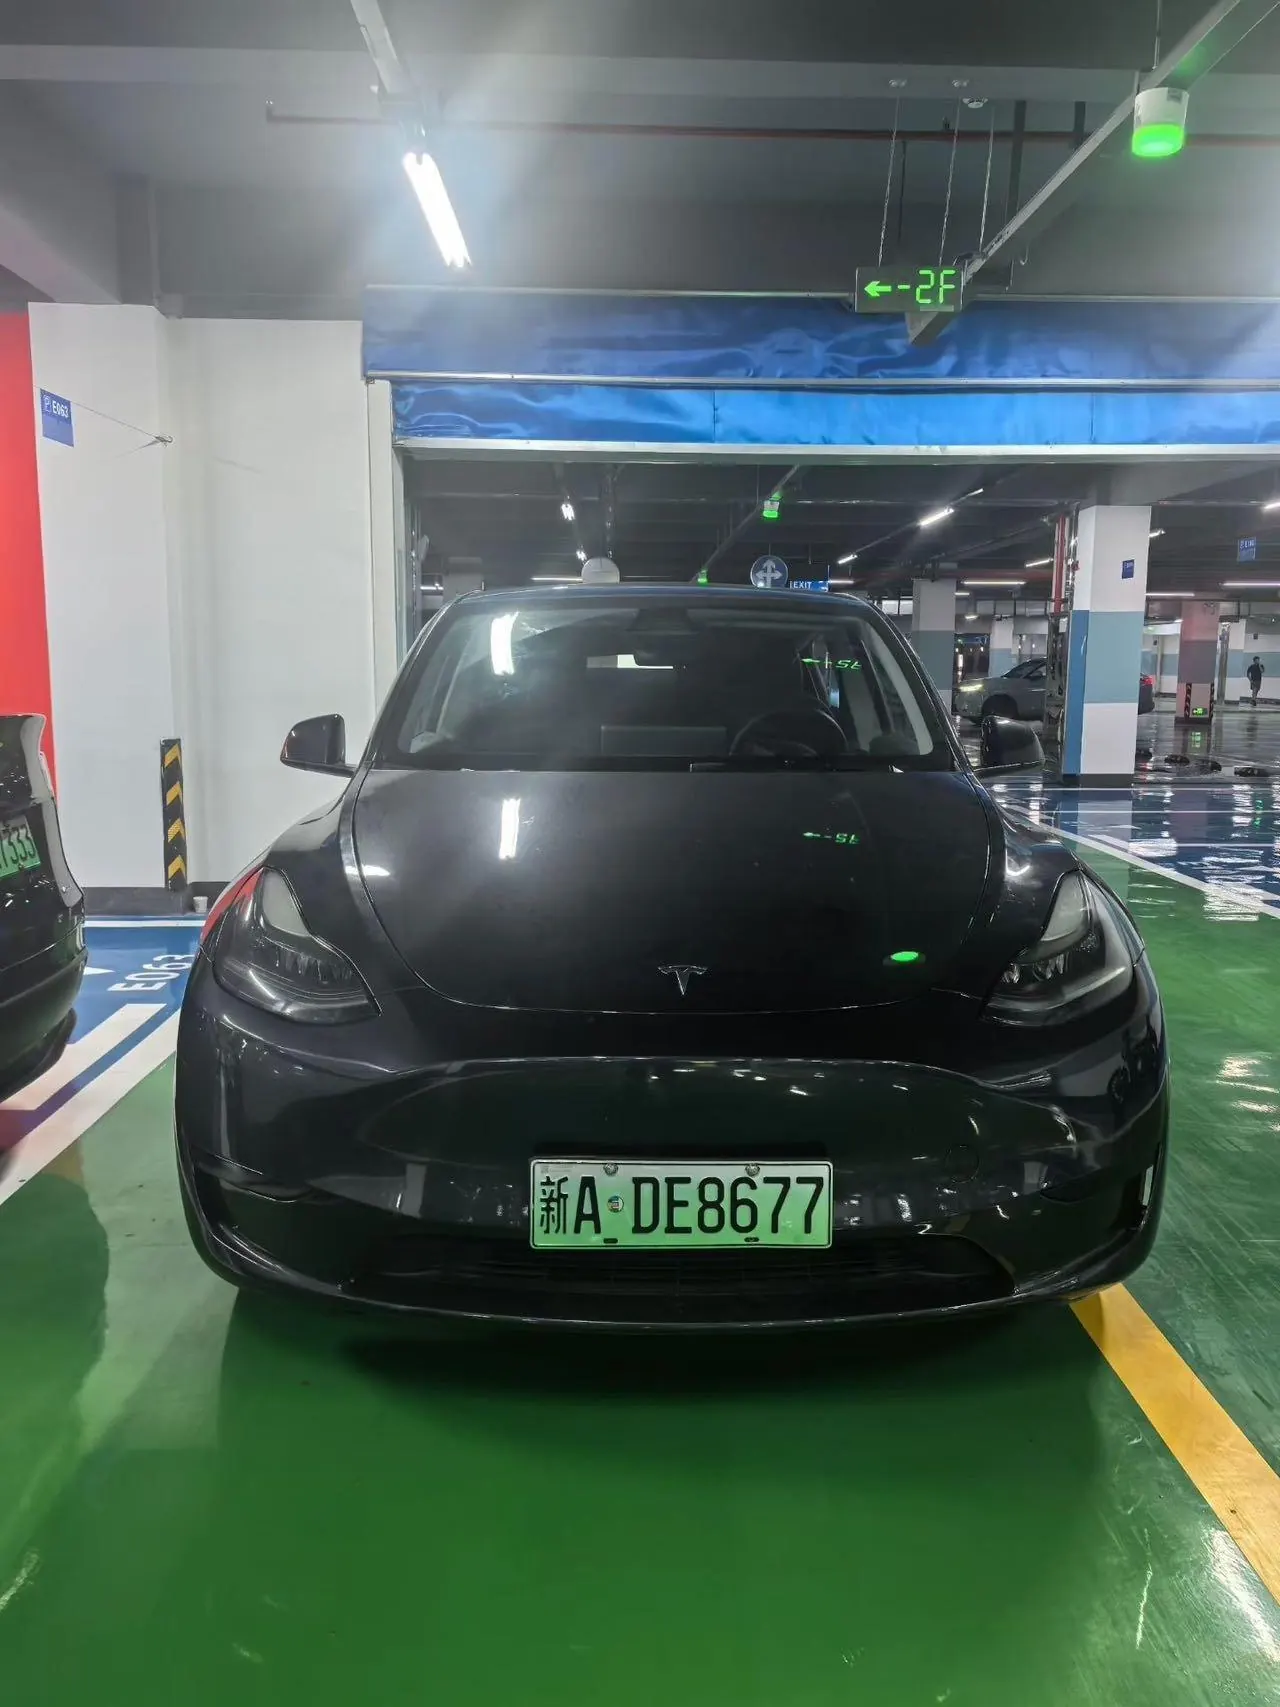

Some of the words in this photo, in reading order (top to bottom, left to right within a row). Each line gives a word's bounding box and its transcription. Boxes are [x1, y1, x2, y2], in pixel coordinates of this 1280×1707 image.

[52, 400, 69, 418] E063
[793, 580, 812, 590] EXIT
[539, 1175, 602, 1234] 新A
[631, 1175, 824, 1235] DE8677
